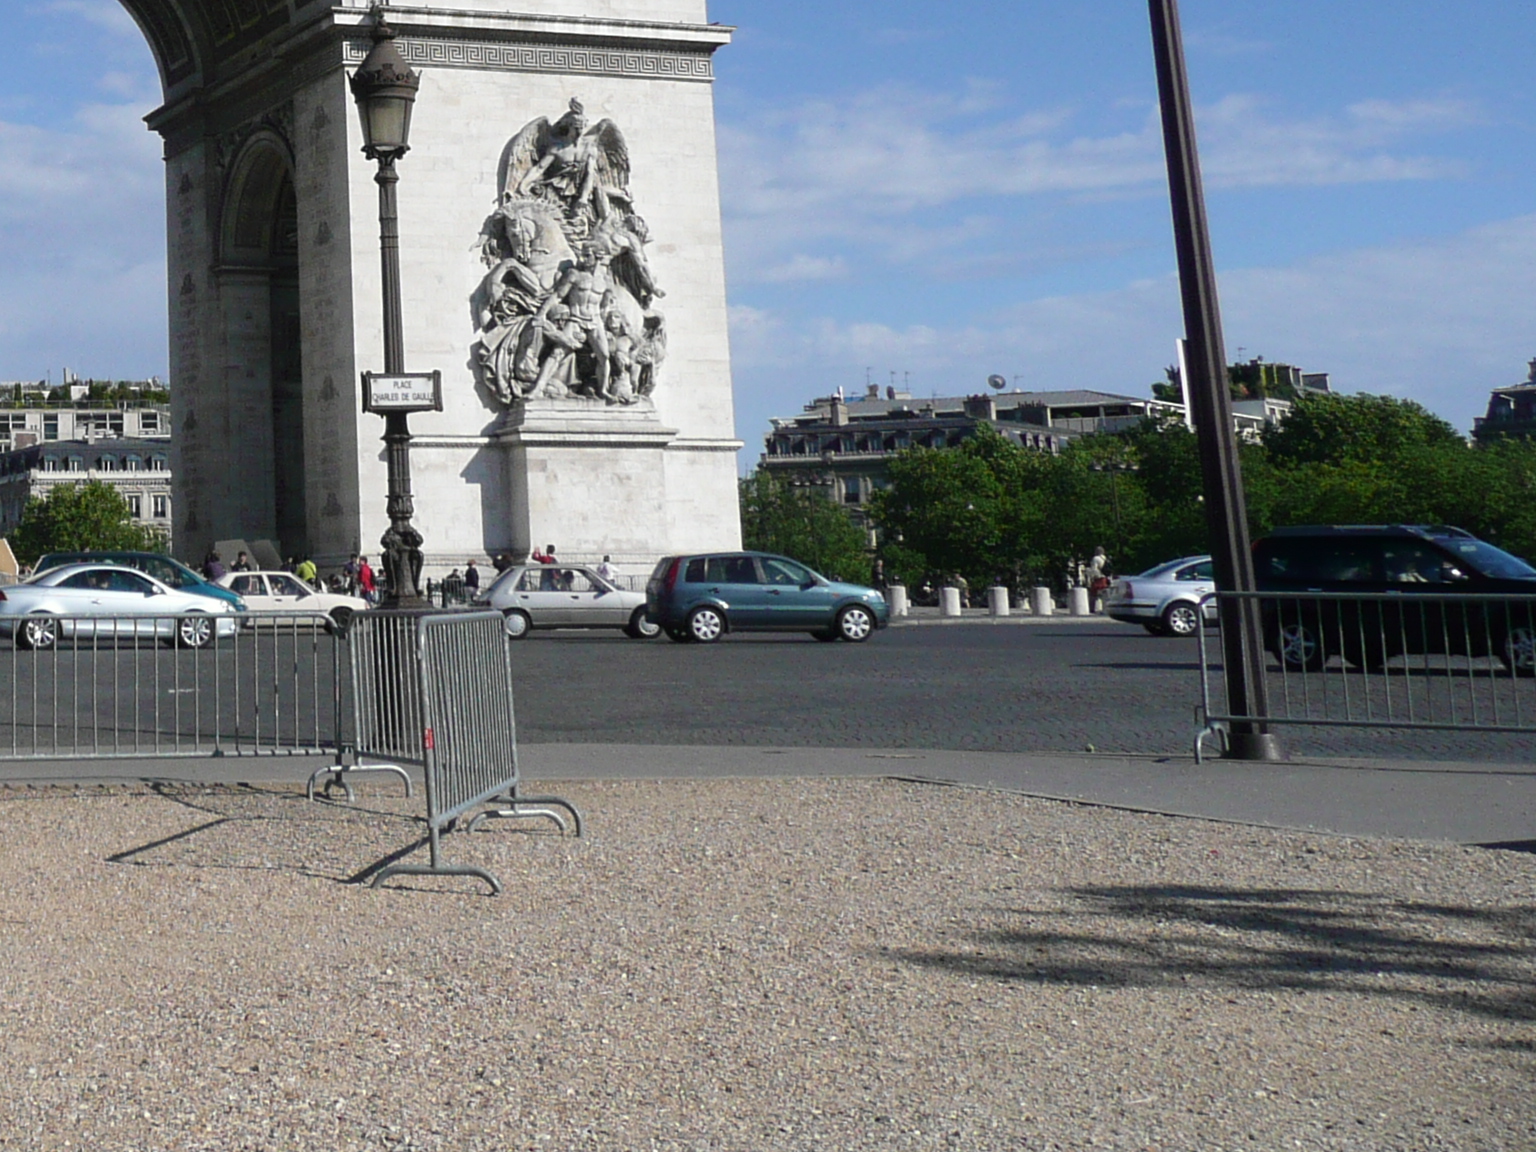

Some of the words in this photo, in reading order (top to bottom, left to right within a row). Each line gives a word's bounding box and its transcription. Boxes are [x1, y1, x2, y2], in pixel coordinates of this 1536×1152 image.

[393, 381, 412, 389] PLACE
[373, 393, 399, 401] CHARLES
[401, 393, 409, 401] DE
